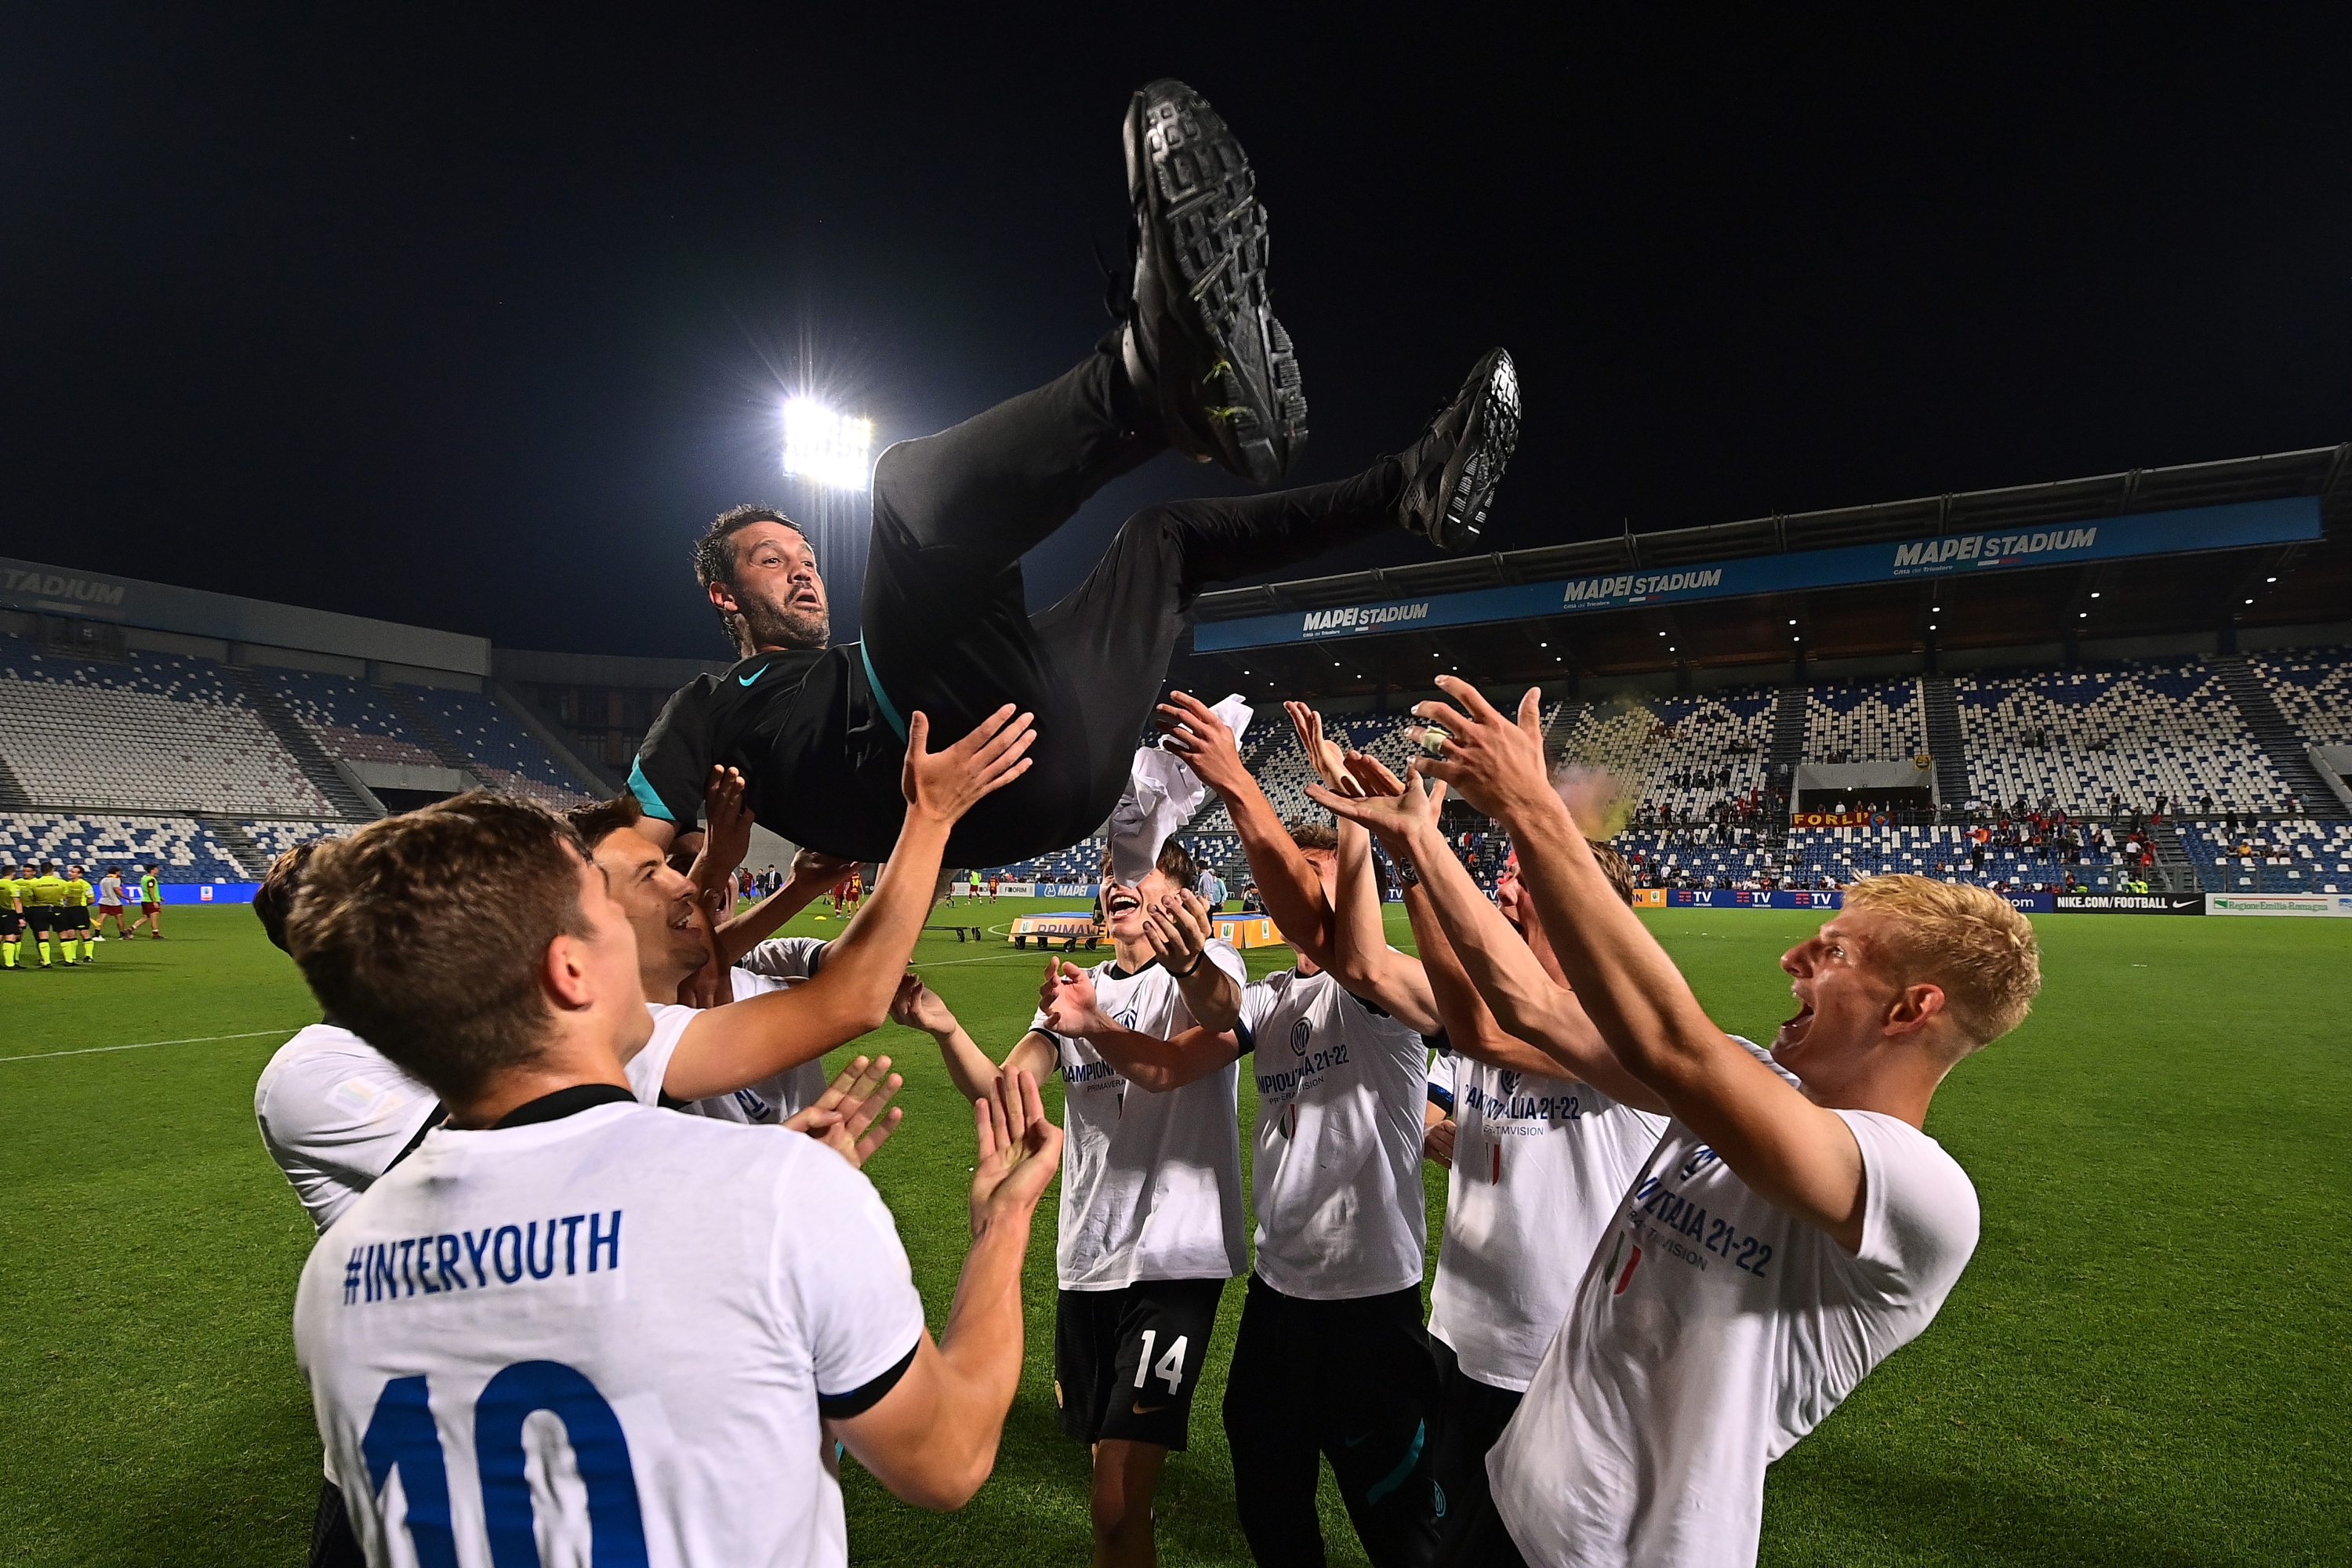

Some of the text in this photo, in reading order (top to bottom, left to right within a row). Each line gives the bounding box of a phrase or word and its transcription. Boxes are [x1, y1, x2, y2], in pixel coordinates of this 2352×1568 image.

[1893, 527, 2097, 567] MAPEI STADIUM
[4, 568, 126, 605] TADIUM
[1563, 568, 1722, 602] MAPEI STADIUM
[1302, 603, 1429, 631] MAPEI STADIUM
[1058, 885, 1088, 897] MAPEI
[1388, 889, 1403, 898] TV
[1693, 891, 1712, 902] TV
[1751, 892, 1771, 903] TV
[1811, 894, 1831, 905] TV
[2011, 898, 2034, 907] om
[2057, 897, 2168, 909] NIKE.COM/FOOTBALL
[1314, 1044, 1349, 1072] 21-22
[1540, 1096, 1581, 1120] 21-22
[345, 1210, 622, 1305] #INTERYOUTH
[1705, 1218, 1773, 1279] 21-22
[1134, 1330, 1188, 1396] 14
[361, 1359, 651, 1568] 10
